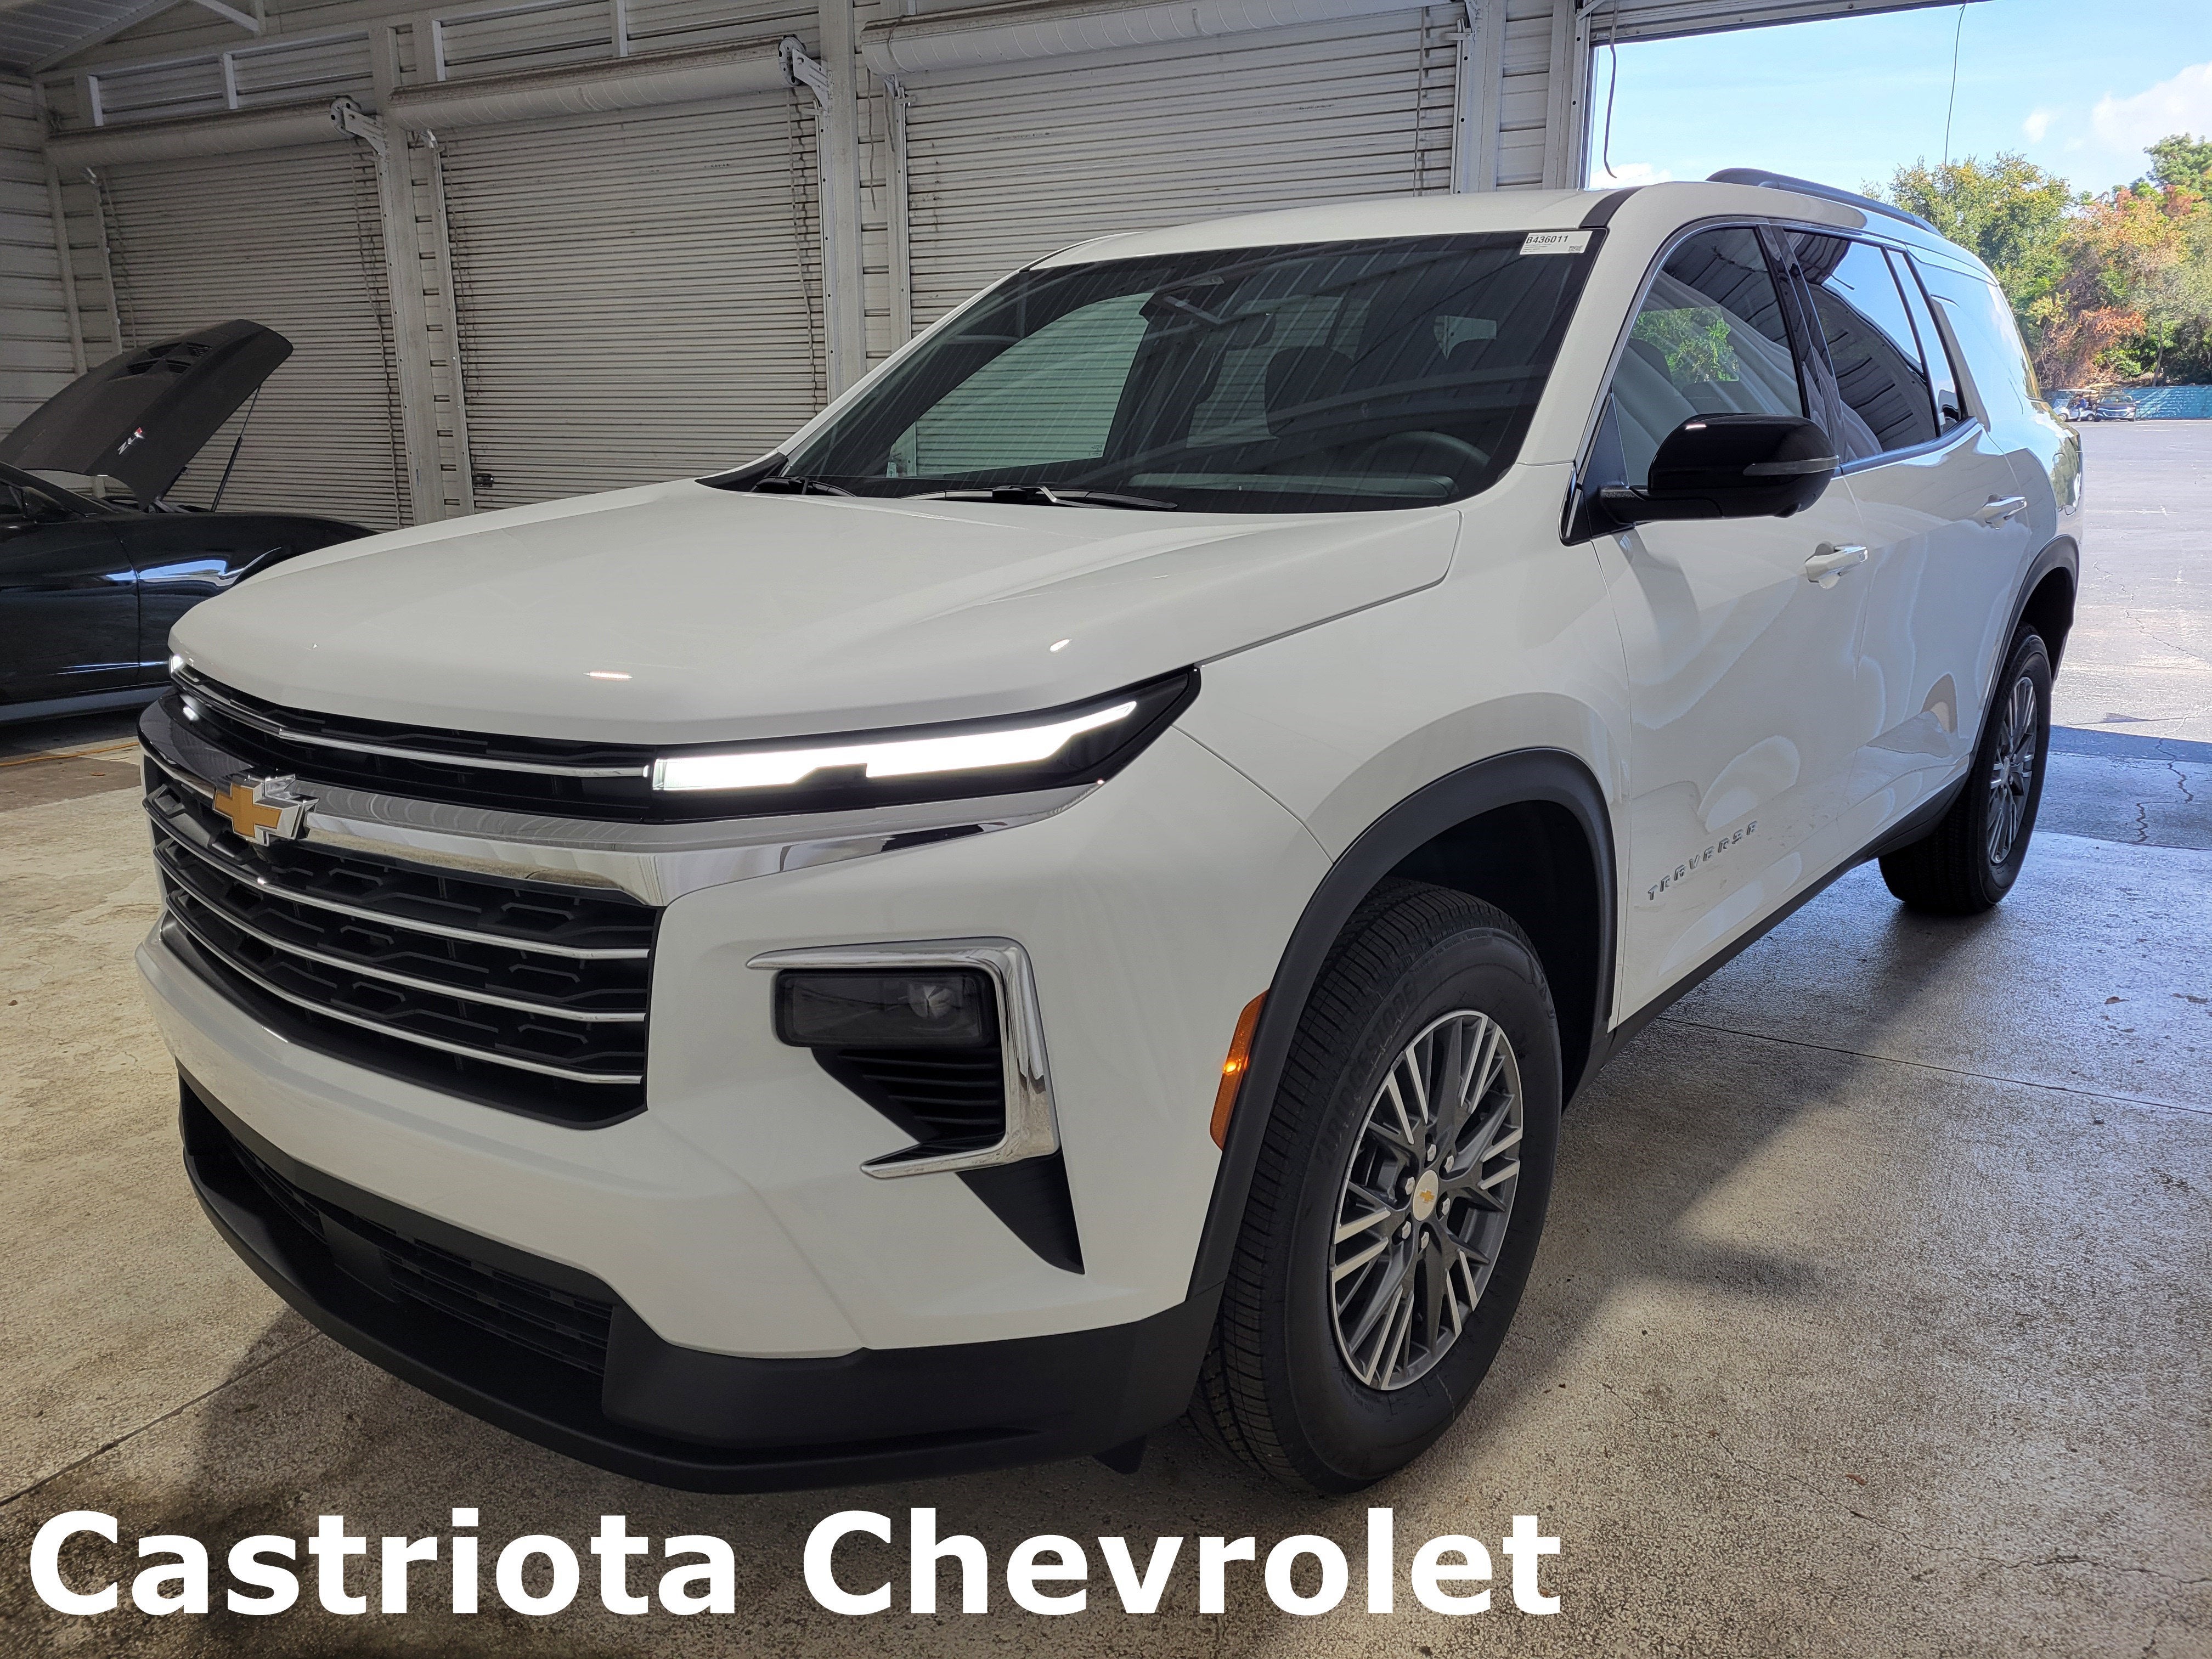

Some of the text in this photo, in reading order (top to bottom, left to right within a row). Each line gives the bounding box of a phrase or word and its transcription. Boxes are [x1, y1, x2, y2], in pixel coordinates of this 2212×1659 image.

[1526, 235, 1568, 244] B436011
[117, 427, 144, 455] ZL1
[1647, 821, 1757, 901] TRAVERSE
